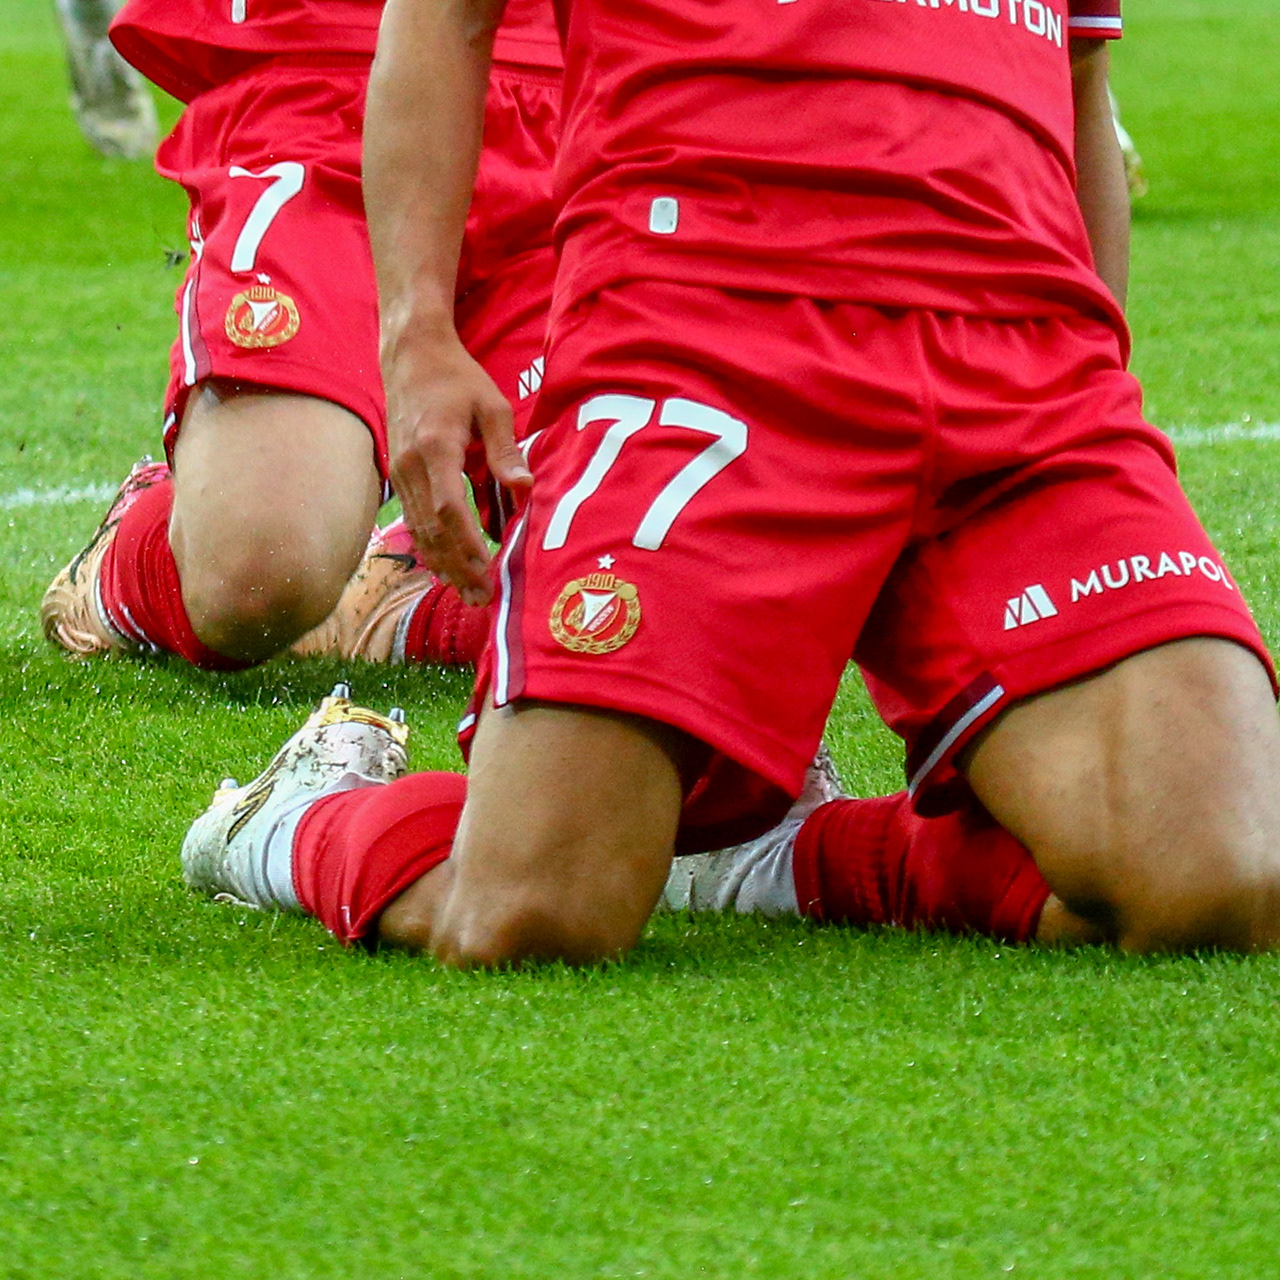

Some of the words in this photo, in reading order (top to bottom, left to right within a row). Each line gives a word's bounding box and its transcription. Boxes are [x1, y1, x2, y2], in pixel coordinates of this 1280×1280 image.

[227, 160, 305, 273] 7
[541, 393, 750, 552] 77
[1070, 550, 1234, 604] MURAPOL
